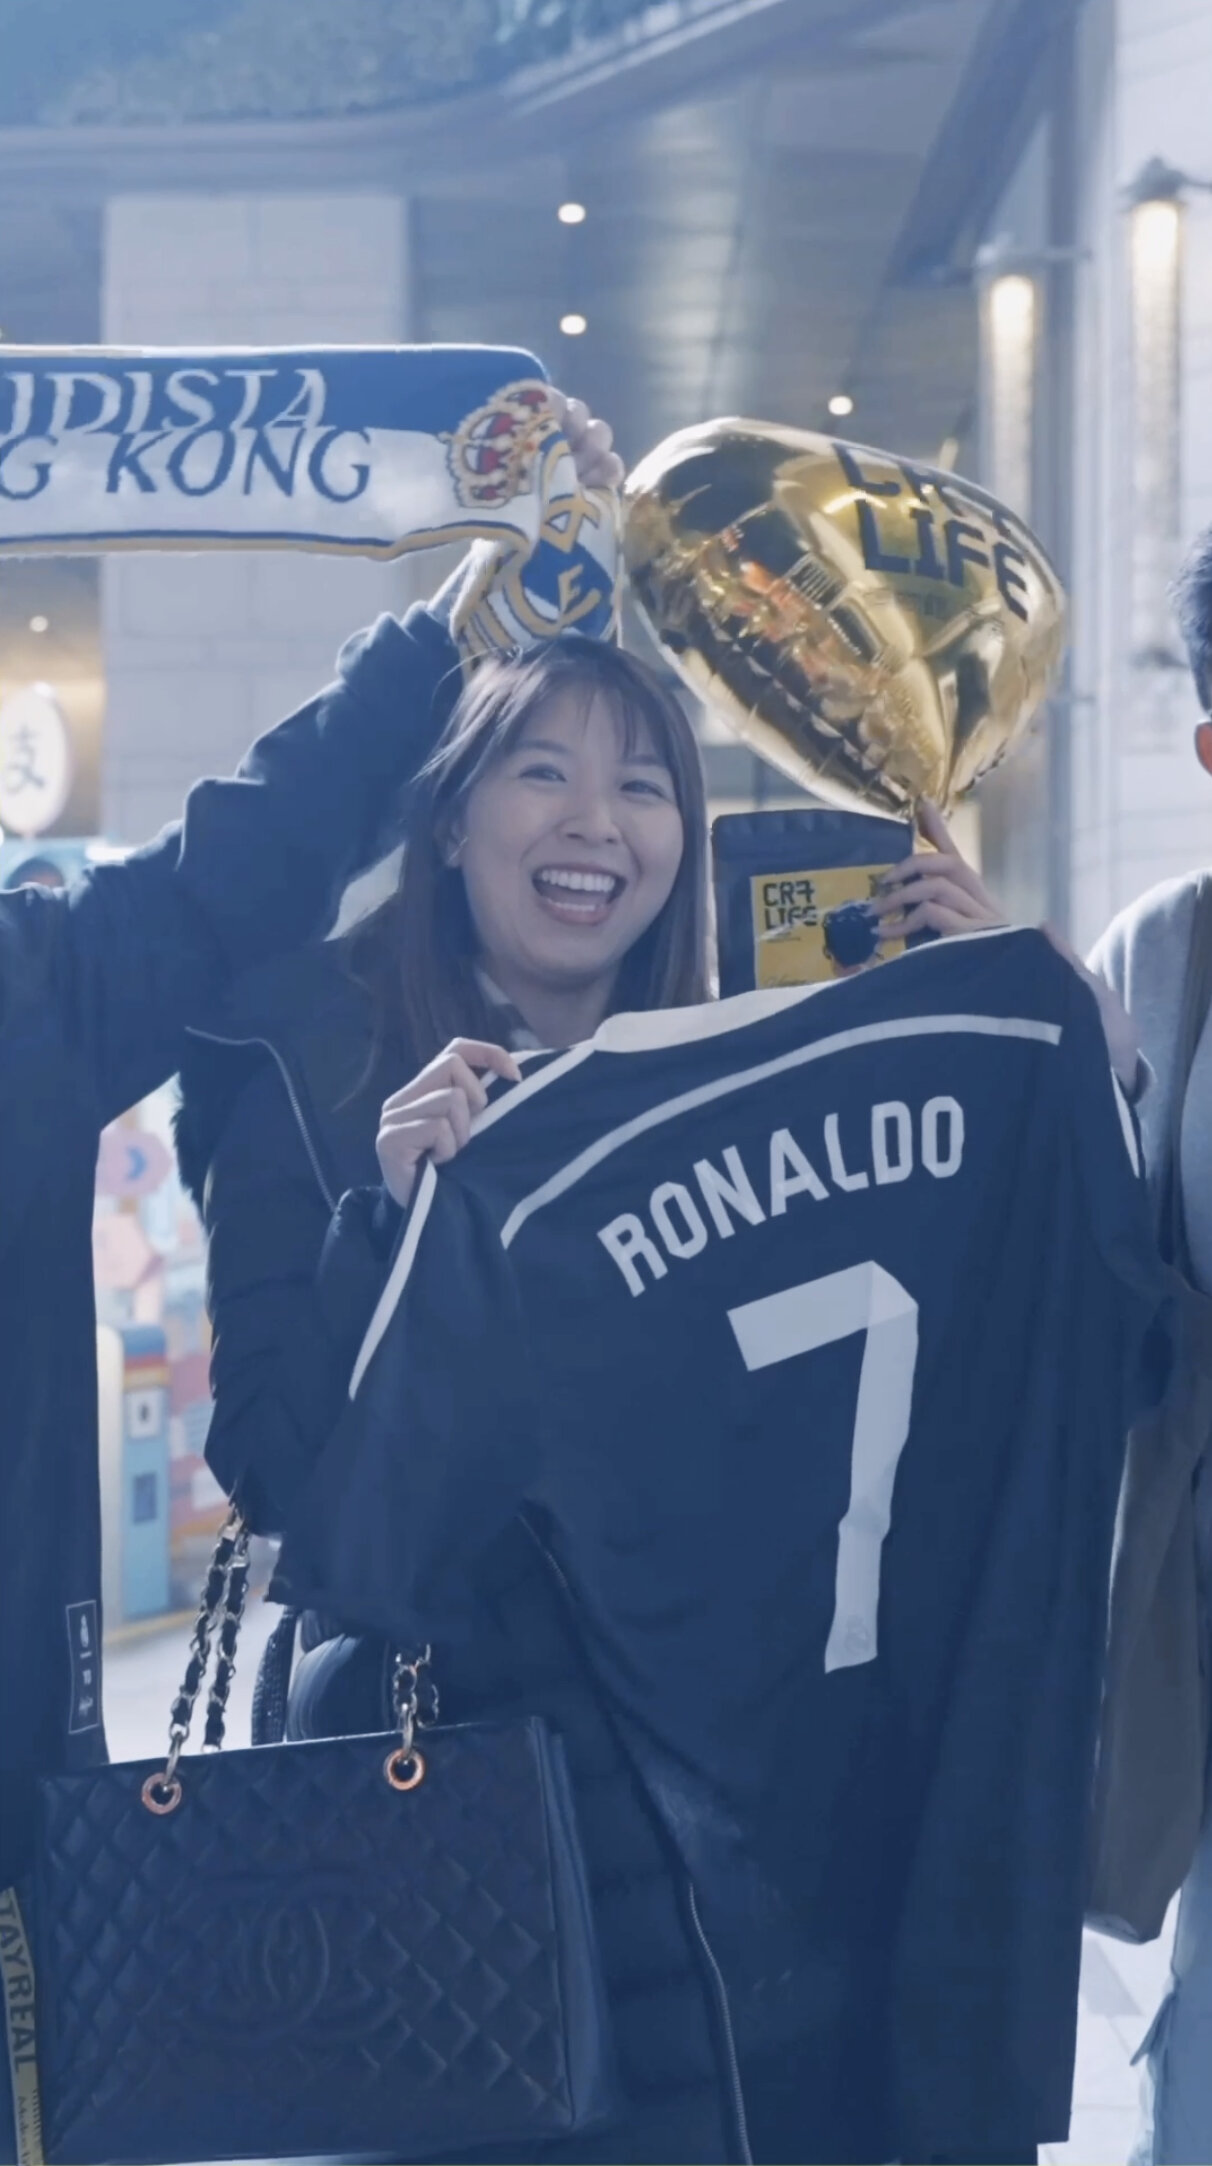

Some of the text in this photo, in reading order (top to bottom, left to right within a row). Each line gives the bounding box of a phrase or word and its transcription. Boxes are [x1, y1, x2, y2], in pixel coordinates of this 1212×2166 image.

[106, 427, 371, 502] KONG
[855, 498, 1029, 623] LIFE
[763, 879, 814, 907] CR7
[764, 906, 817, 931] LIFE
[597, 1096, 964, 1297] RONALDO
[725, 1260, 919, 1673] 7
